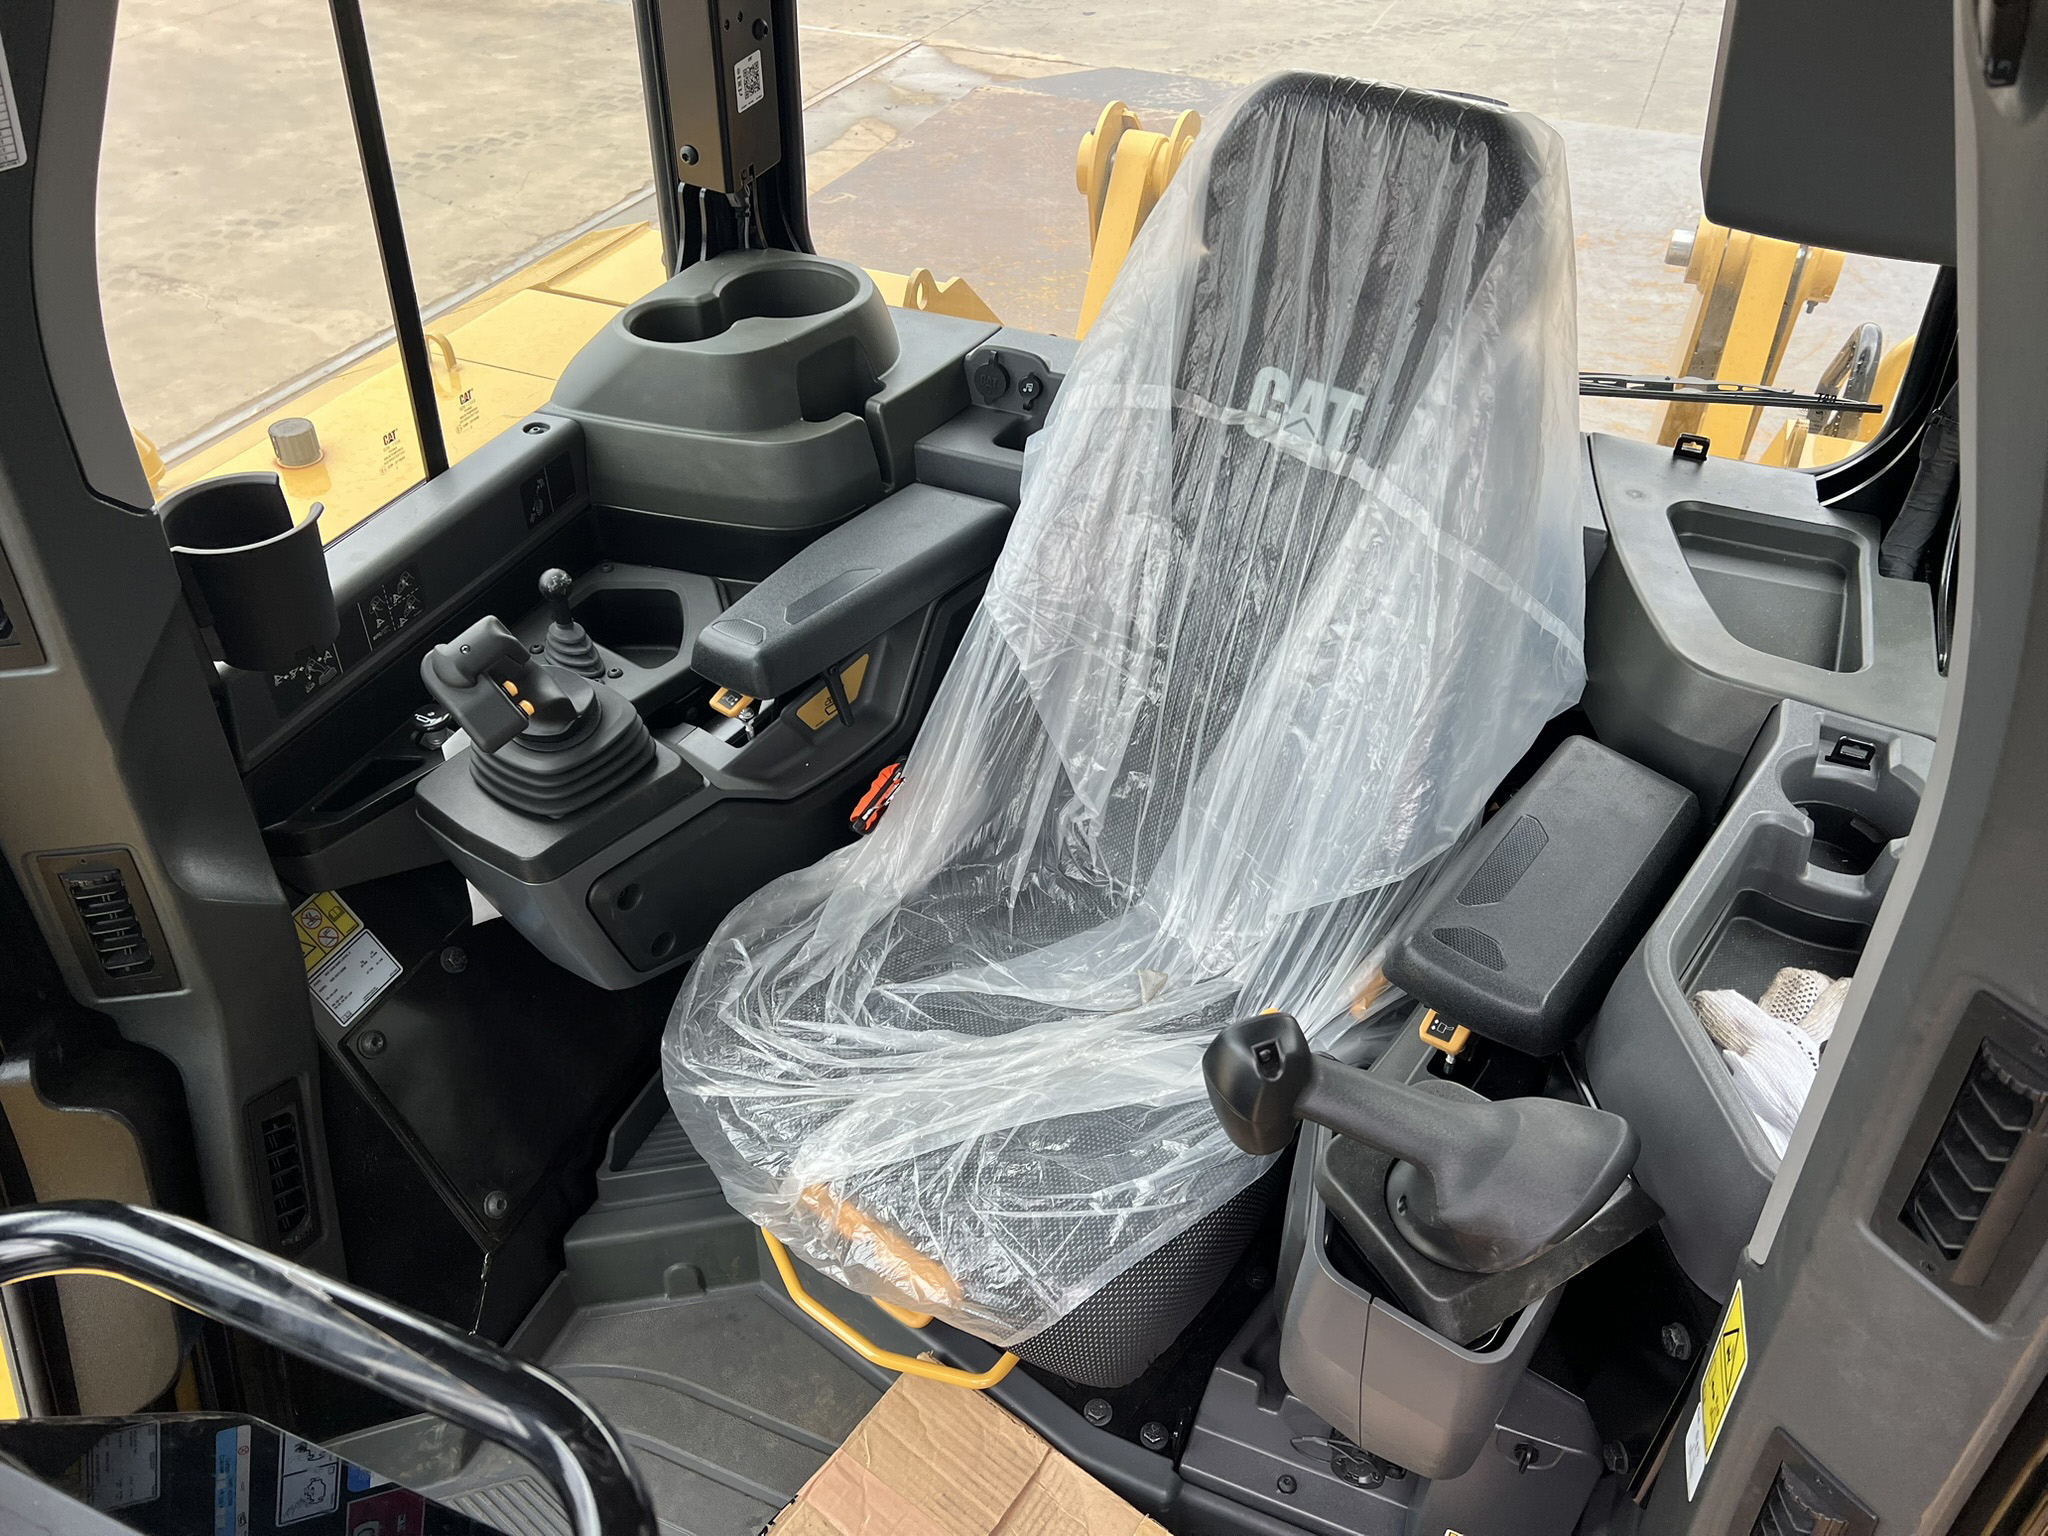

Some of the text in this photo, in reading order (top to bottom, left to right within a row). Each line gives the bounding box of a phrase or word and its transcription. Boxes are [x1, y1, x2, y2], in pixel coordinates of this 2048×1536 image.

[980, 374, 998, 388] CAT
[459, 389, 472, 405] CAT
[1244, 366, 1367, 455] CAT
[383, 431, 396, 446] CAT
